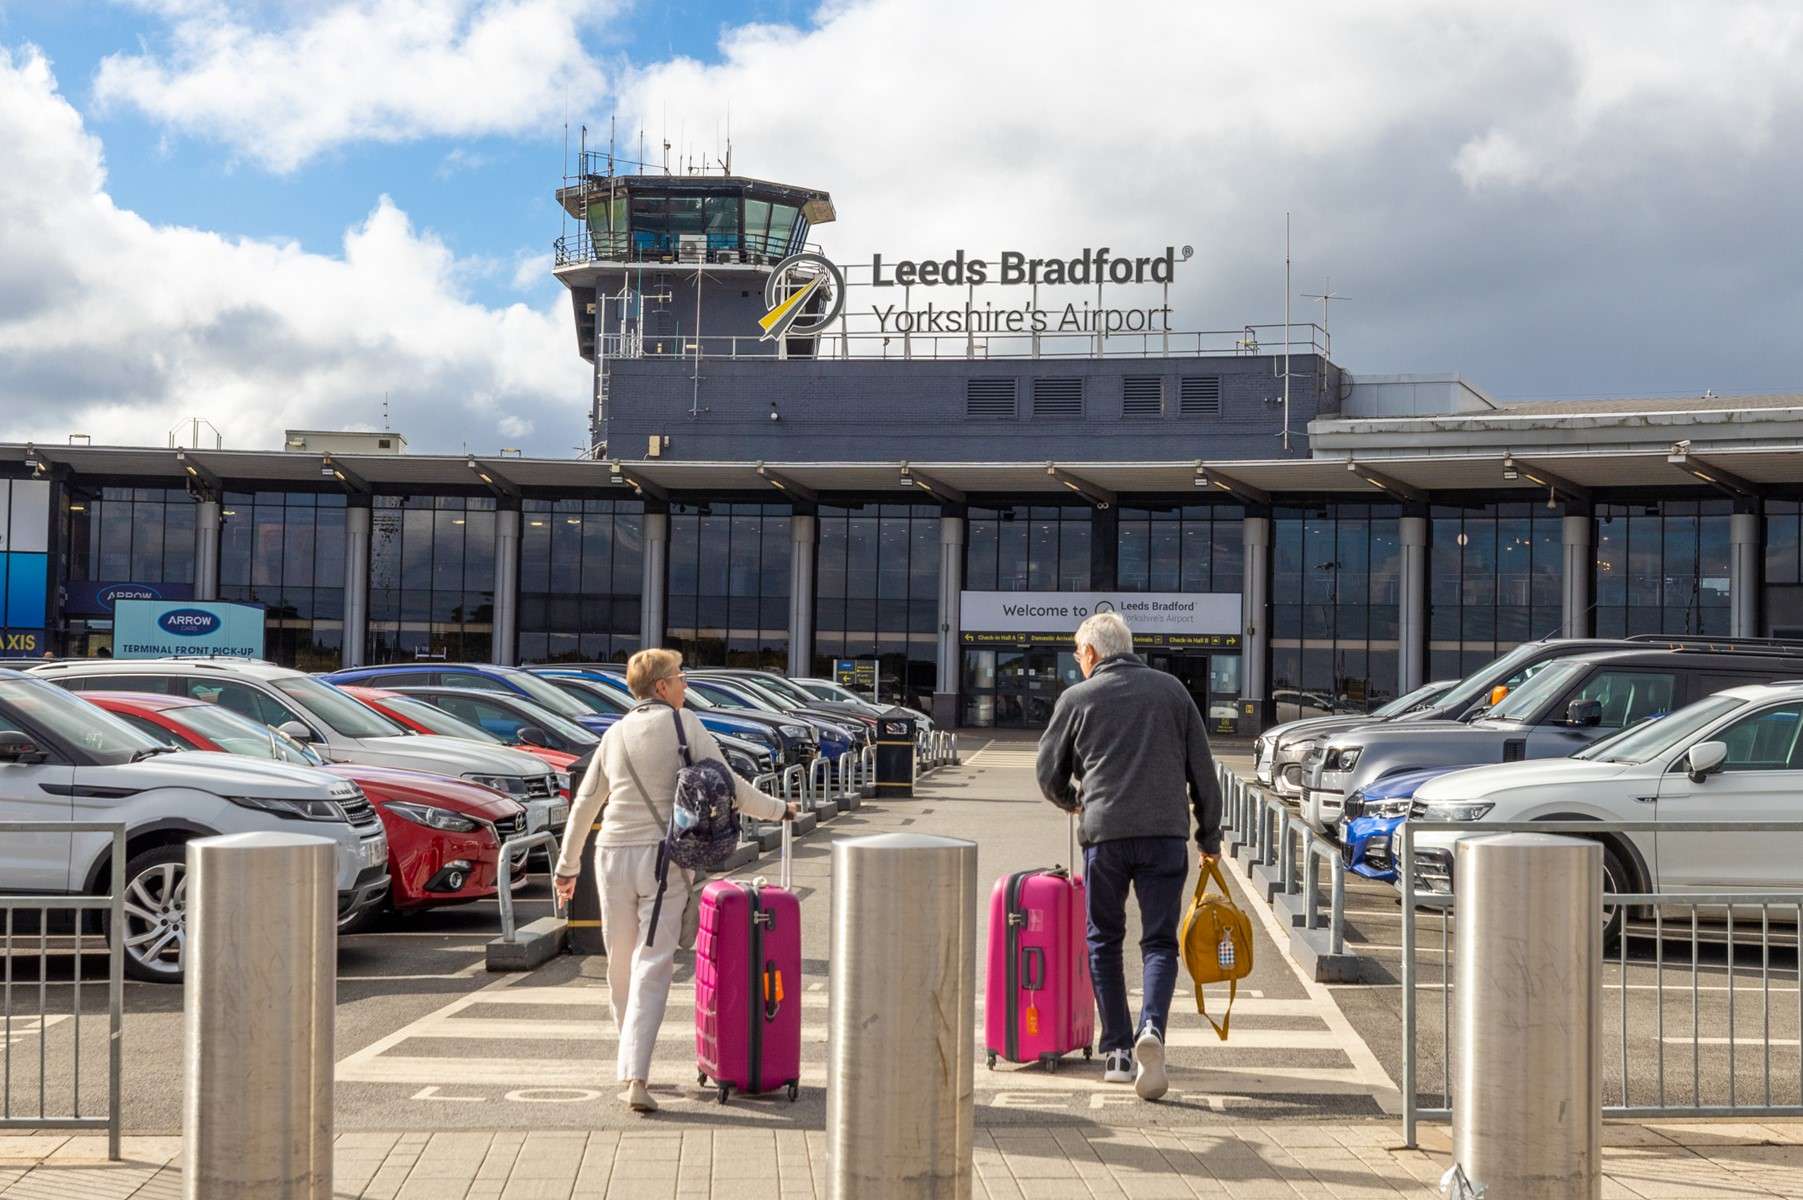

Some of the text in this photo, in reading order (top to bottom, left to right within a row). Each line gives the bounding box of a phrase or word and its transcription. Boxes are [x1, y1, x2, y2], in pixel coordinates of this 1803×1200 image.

[872, 249, 987, 287] Leeds
[872, 301, 1173, 340] Yorkshire's Airport
[1002, 604, 1088, 617] Welcome to
[1120, 601, 1194, 611] Leeds Bradford
[168, 615, 211, 625] ARROW
[1166, 613, 1194, 624] Airport
[123, 644, 254, 656] TERMINAL FRONT PICK-UP
